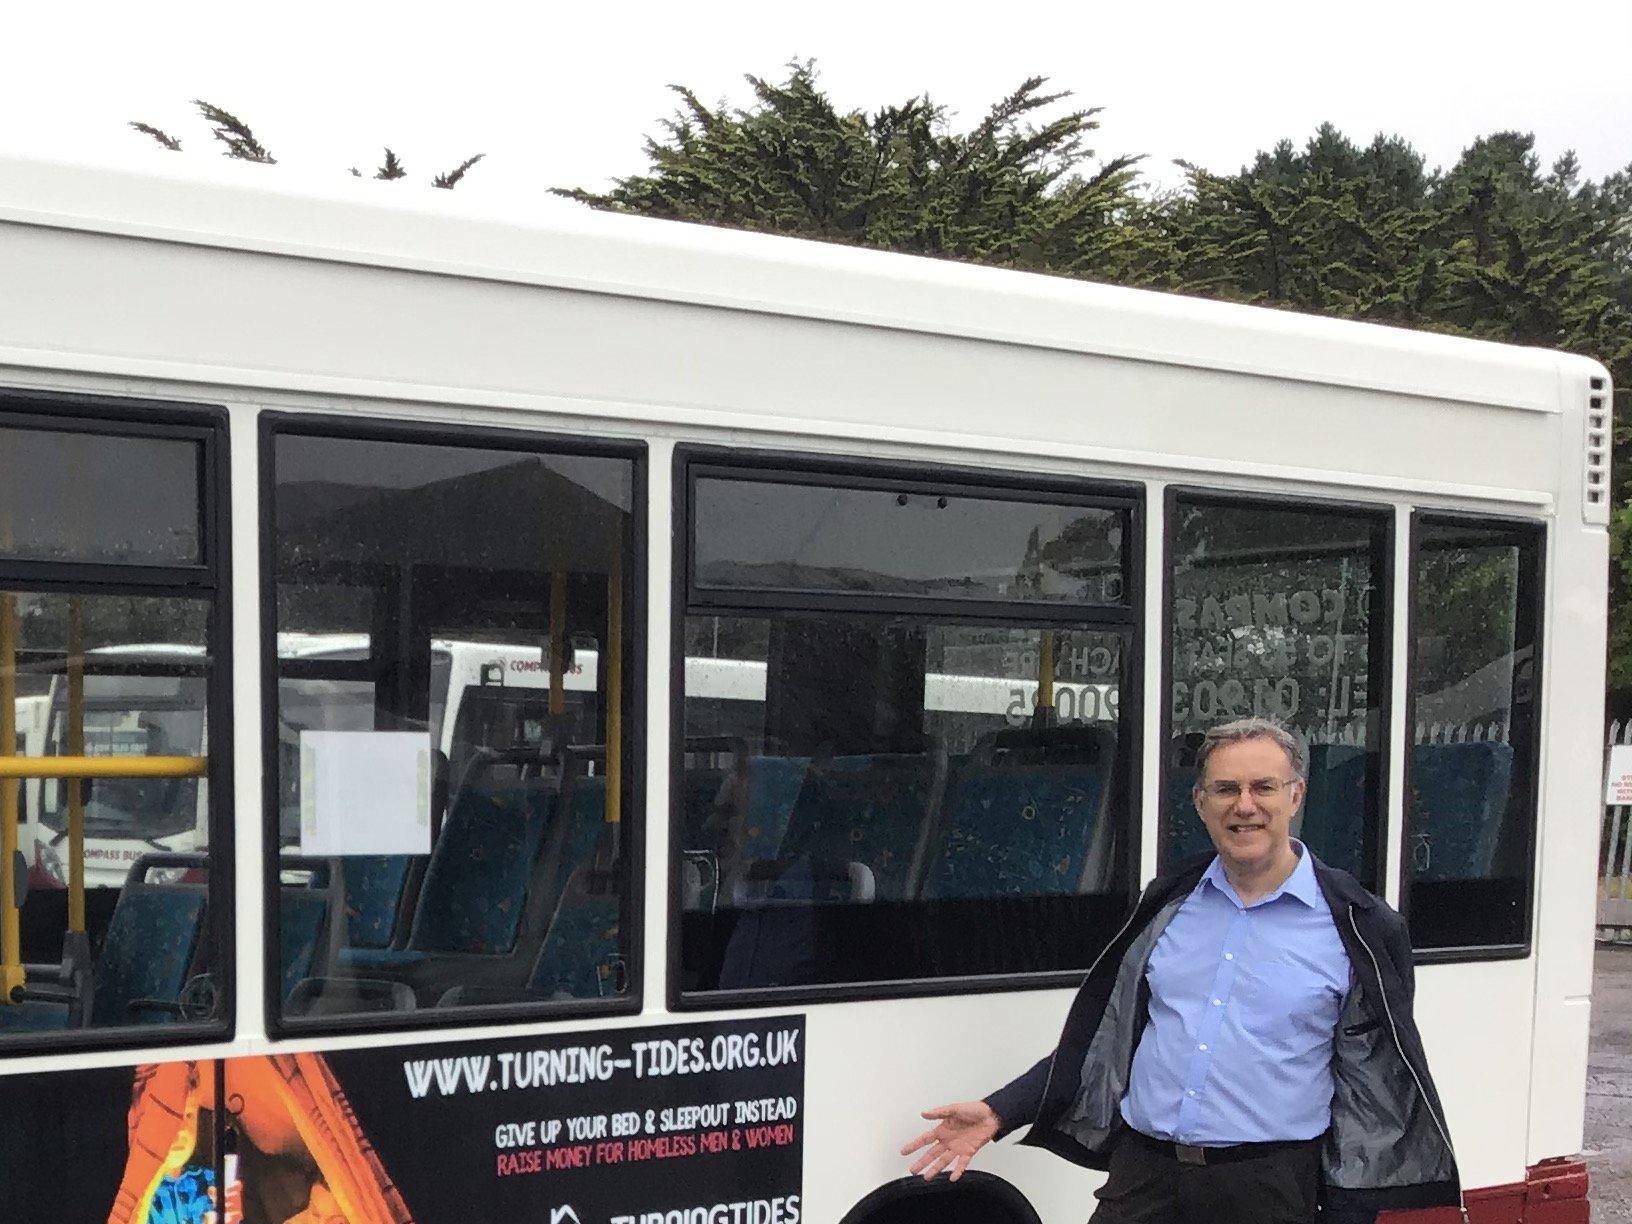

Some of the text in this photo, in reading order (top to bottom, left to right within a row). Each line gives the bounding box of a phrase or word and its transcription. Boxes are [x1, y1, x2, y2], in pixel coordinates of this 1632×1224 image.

[404, 1029, 798, 1098] WWW.TURNING-TIDES.ORG.UK
[495, 1097, 797, 1148] GIVE UP YOUR BED & SLEEPOUT INSTEAD
[497, 1124, 794, 1178] RAISE MONEY FOR HOMELESS MEN & WOMEN
